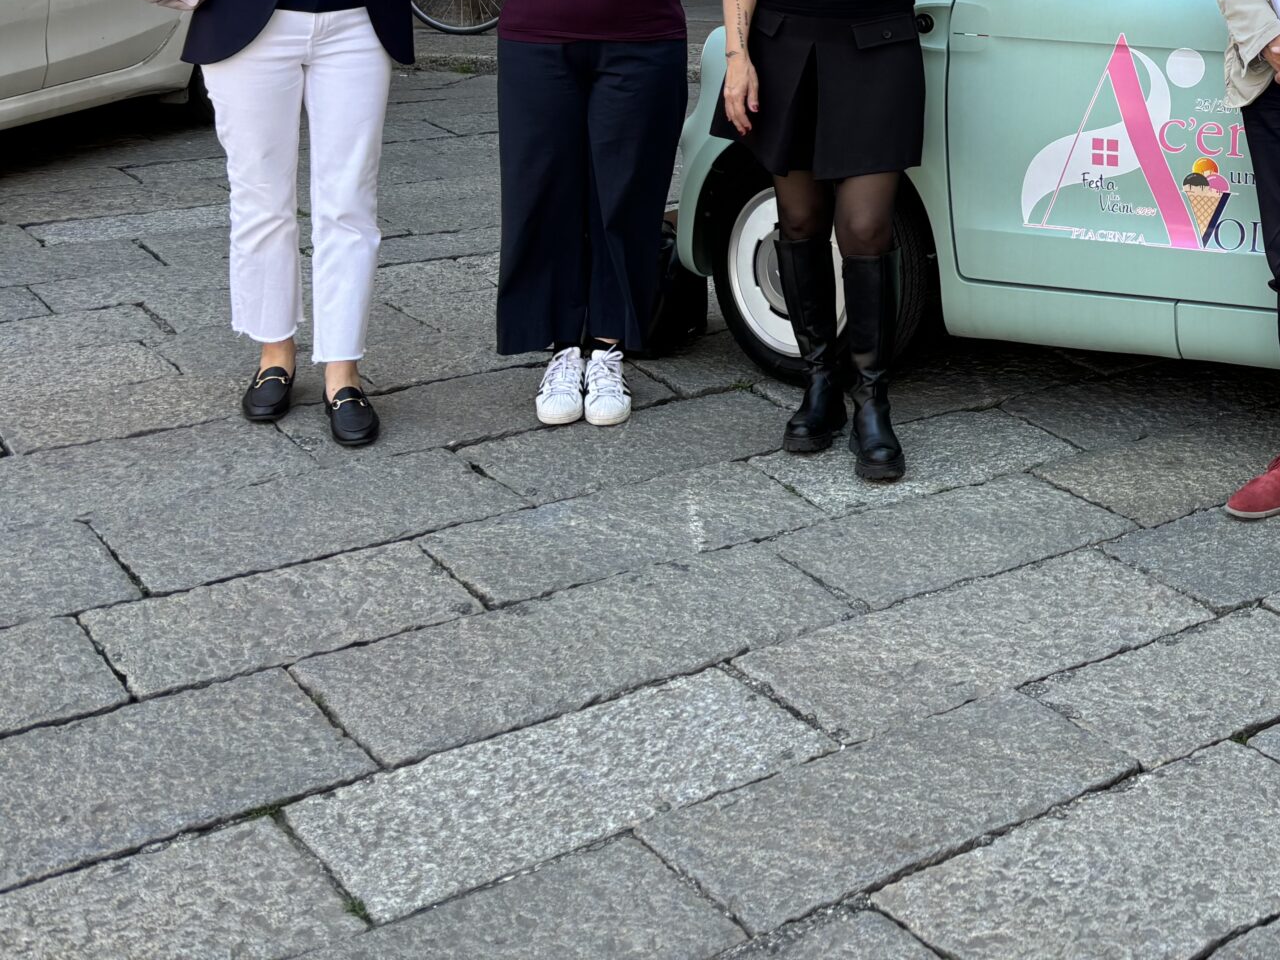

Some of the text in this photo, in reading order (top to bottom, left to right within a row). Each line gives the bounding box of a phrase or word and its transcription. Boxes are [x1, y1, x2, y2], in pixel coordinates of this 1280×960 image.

[1158, 117, 1247, 158] c'er
[1081, 171, 1117, 191] Festa
[1230, 171, 1256, 185] un
[1071, 227, 1146, 245] PIACENZA
